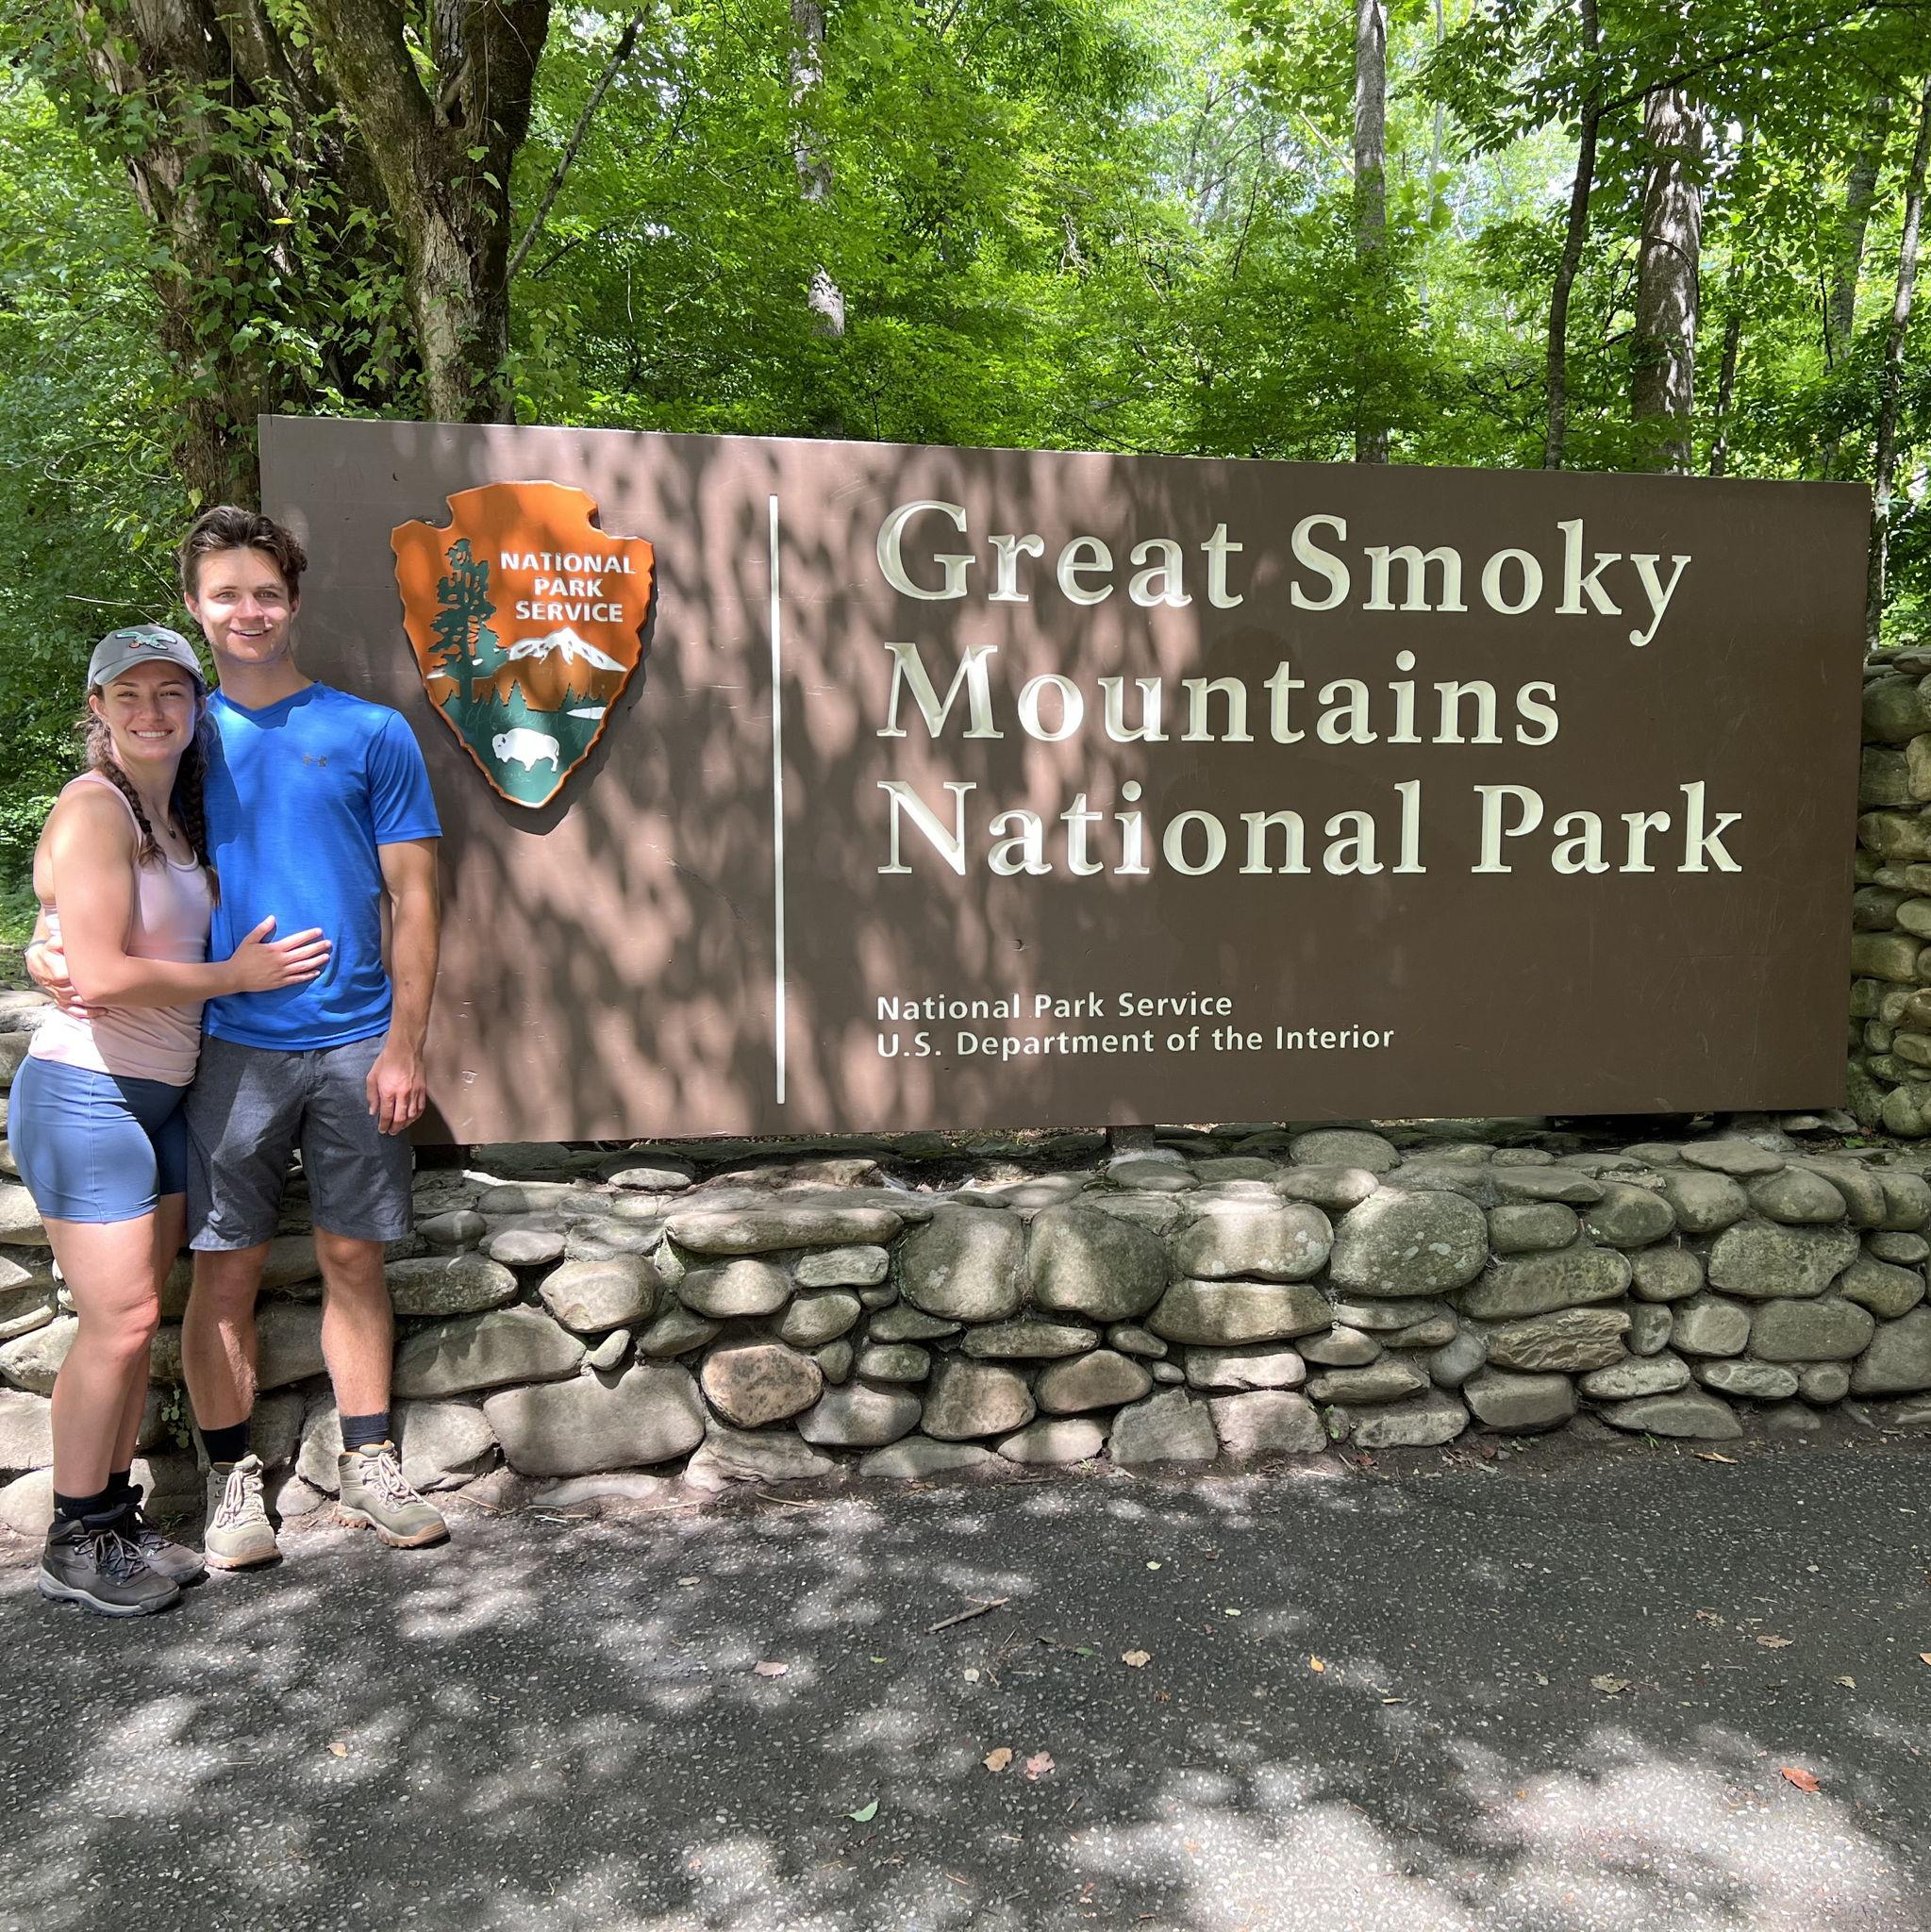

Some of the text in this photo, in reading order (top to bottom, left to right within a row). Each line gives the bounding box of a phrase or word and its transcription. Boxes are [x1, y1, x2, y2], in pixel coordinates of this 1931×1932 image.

[500, 550, 636, 575] NATIONAL
[875, 499, 1691, 647] Great Smoky
[534, 576, 604, 597] PARK
[515, 600, 624, 623] SERVICE
[876, 641, 1559, 746] Mountains
[876, 779, 1743, 876] National Park
[876, 991, 1232, 1021] National Park Service
[876, 1024, 1394, 1062] U.S. Department of the Interior
